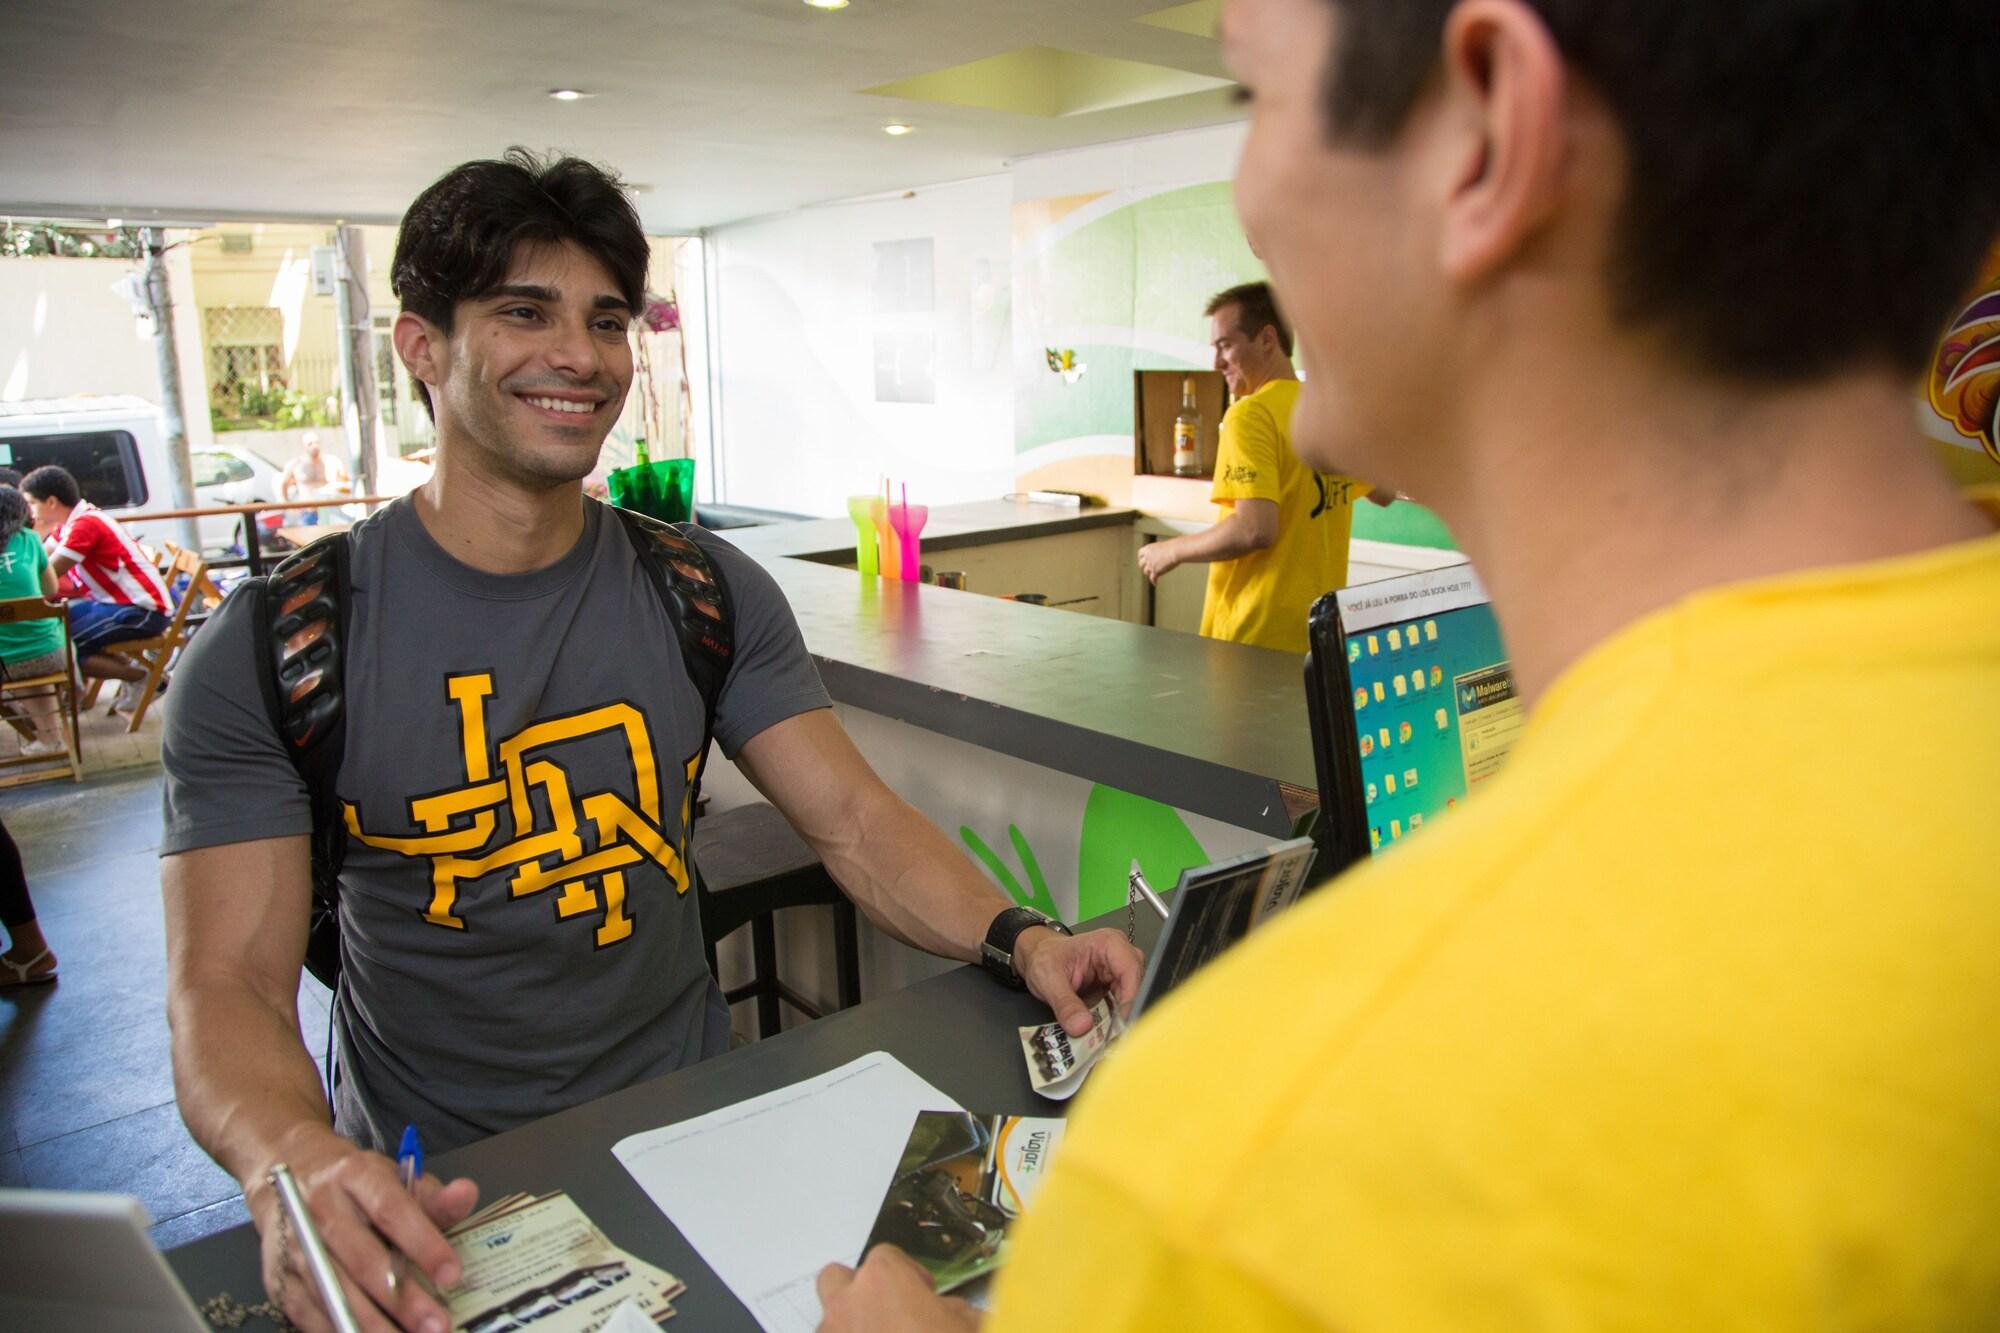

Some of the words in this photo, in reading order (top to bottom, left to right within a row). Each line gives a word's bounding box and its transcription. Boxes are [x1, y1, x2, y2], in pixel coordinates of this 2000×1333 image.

[1409, 591, 1418, 600] DO
[1420, 589, 1431, 598] LOG
[1431, 586, 1446, 597] BOOK
